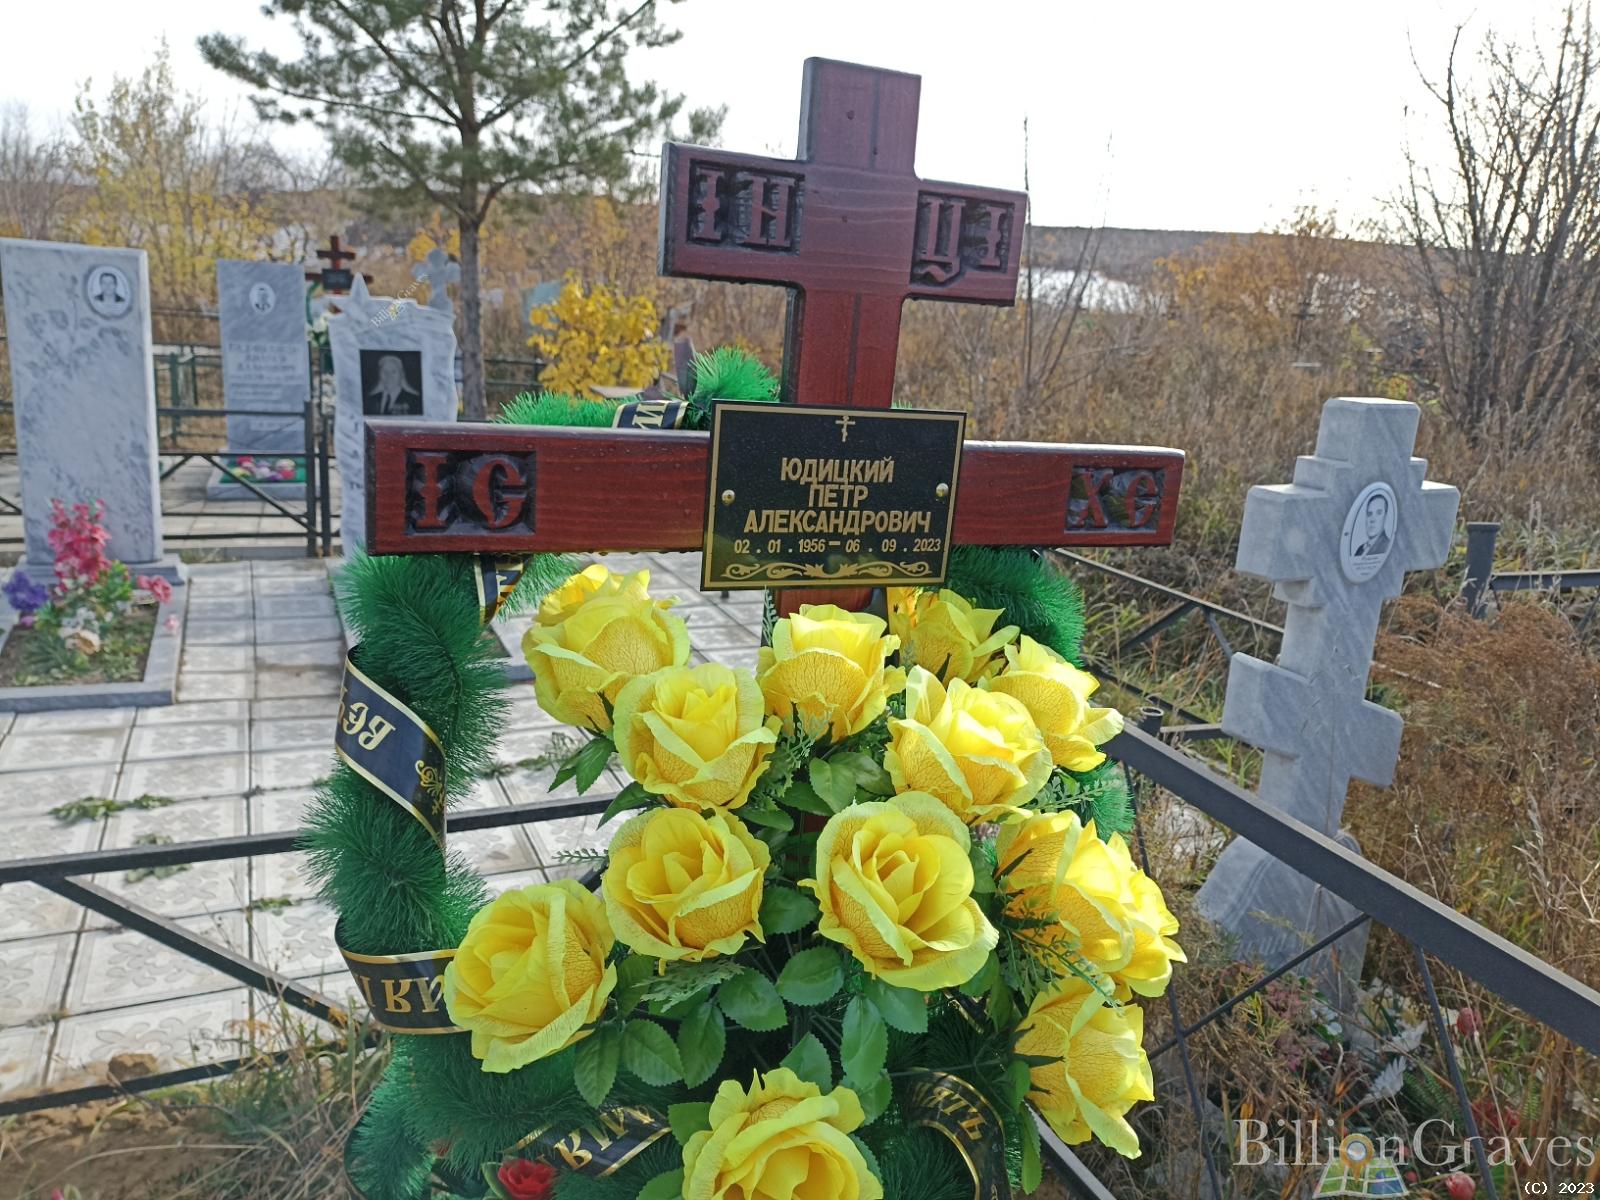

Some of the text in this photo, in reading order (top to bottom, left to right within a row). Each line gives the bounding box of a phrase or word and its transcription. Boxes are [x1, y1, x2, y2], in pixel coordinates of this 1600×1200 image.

[780, 455, 895, 485] ЮДИЦКИЙ
[808, 484, 869, 508] ПЕТР
[743, 509, 932, 536] АЛЕКСАНДРОВИЧ
